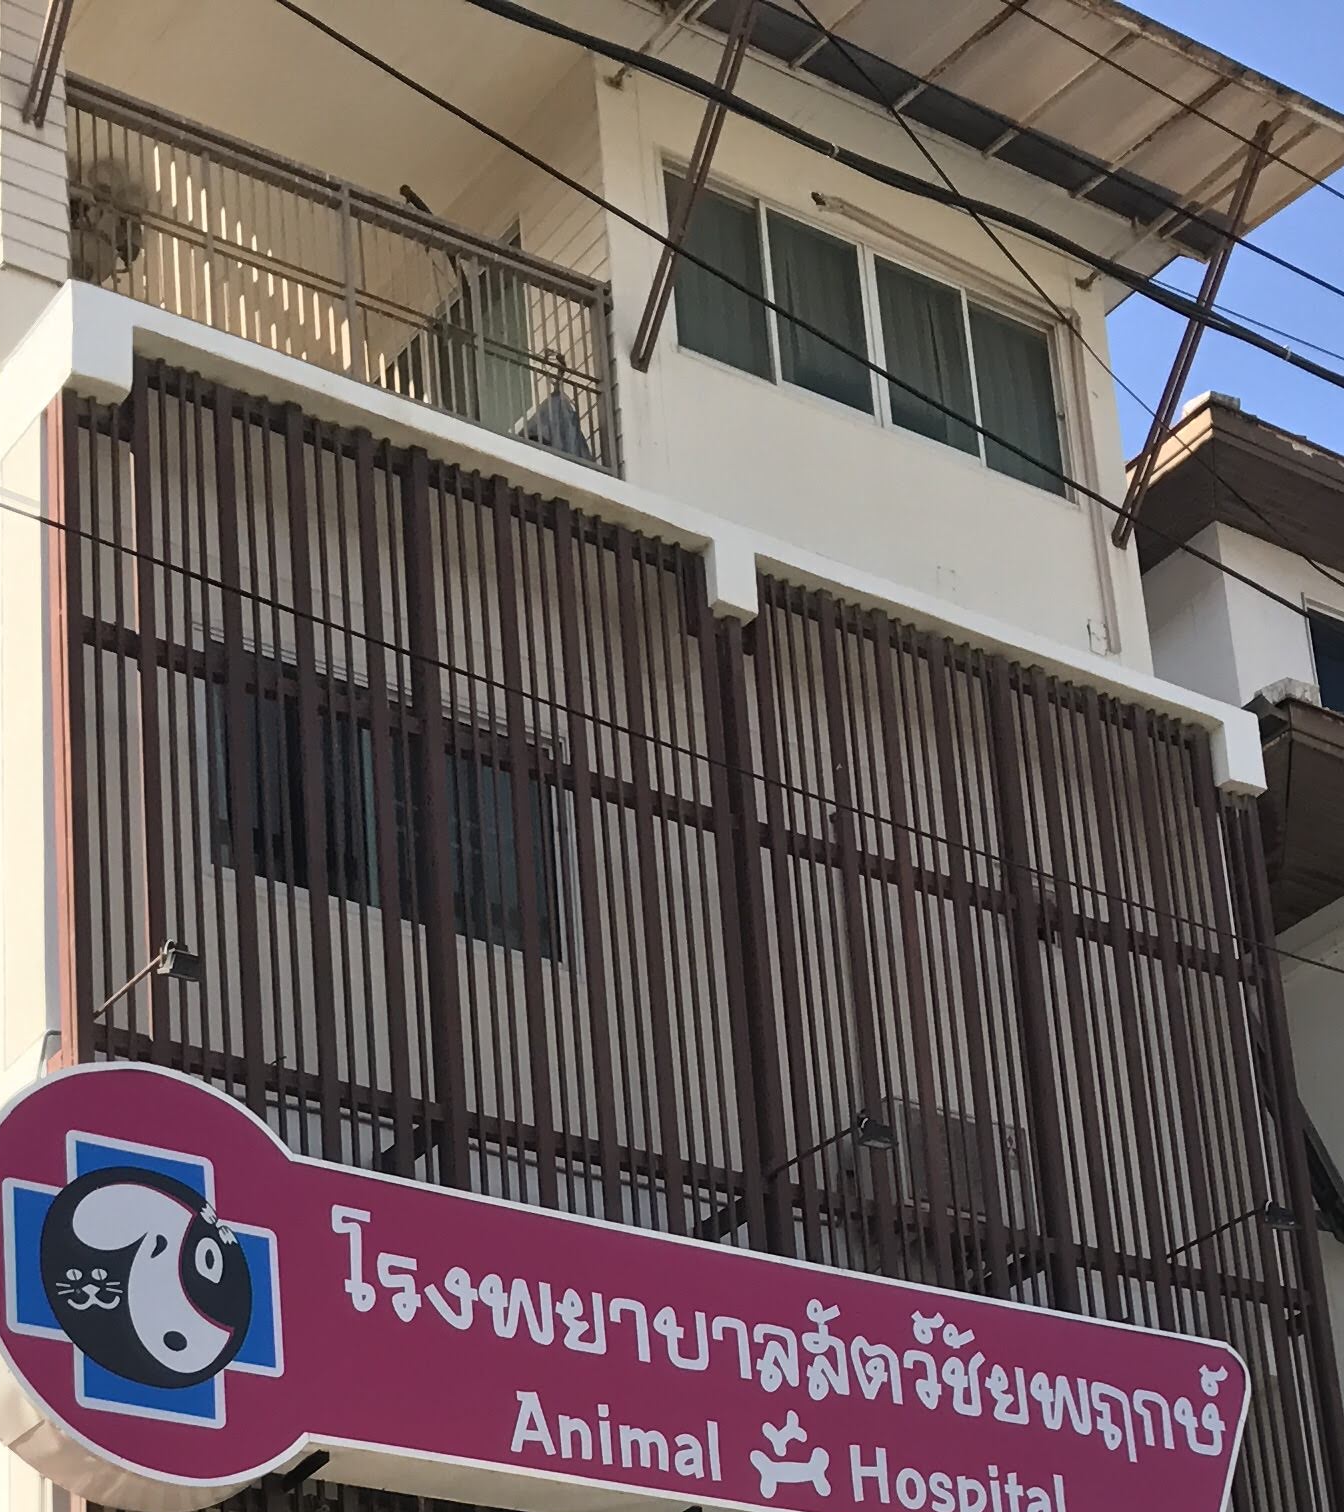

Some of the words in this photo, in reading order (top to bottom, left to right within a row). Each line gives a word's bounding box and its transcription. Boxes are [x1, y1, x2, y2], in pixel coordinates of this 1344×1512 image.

[331, 1203, 1230, 1463] โรงพยาบาลสัตว์ชัยพฤกษ์
[510, 1390, 723, 1484] Animal
